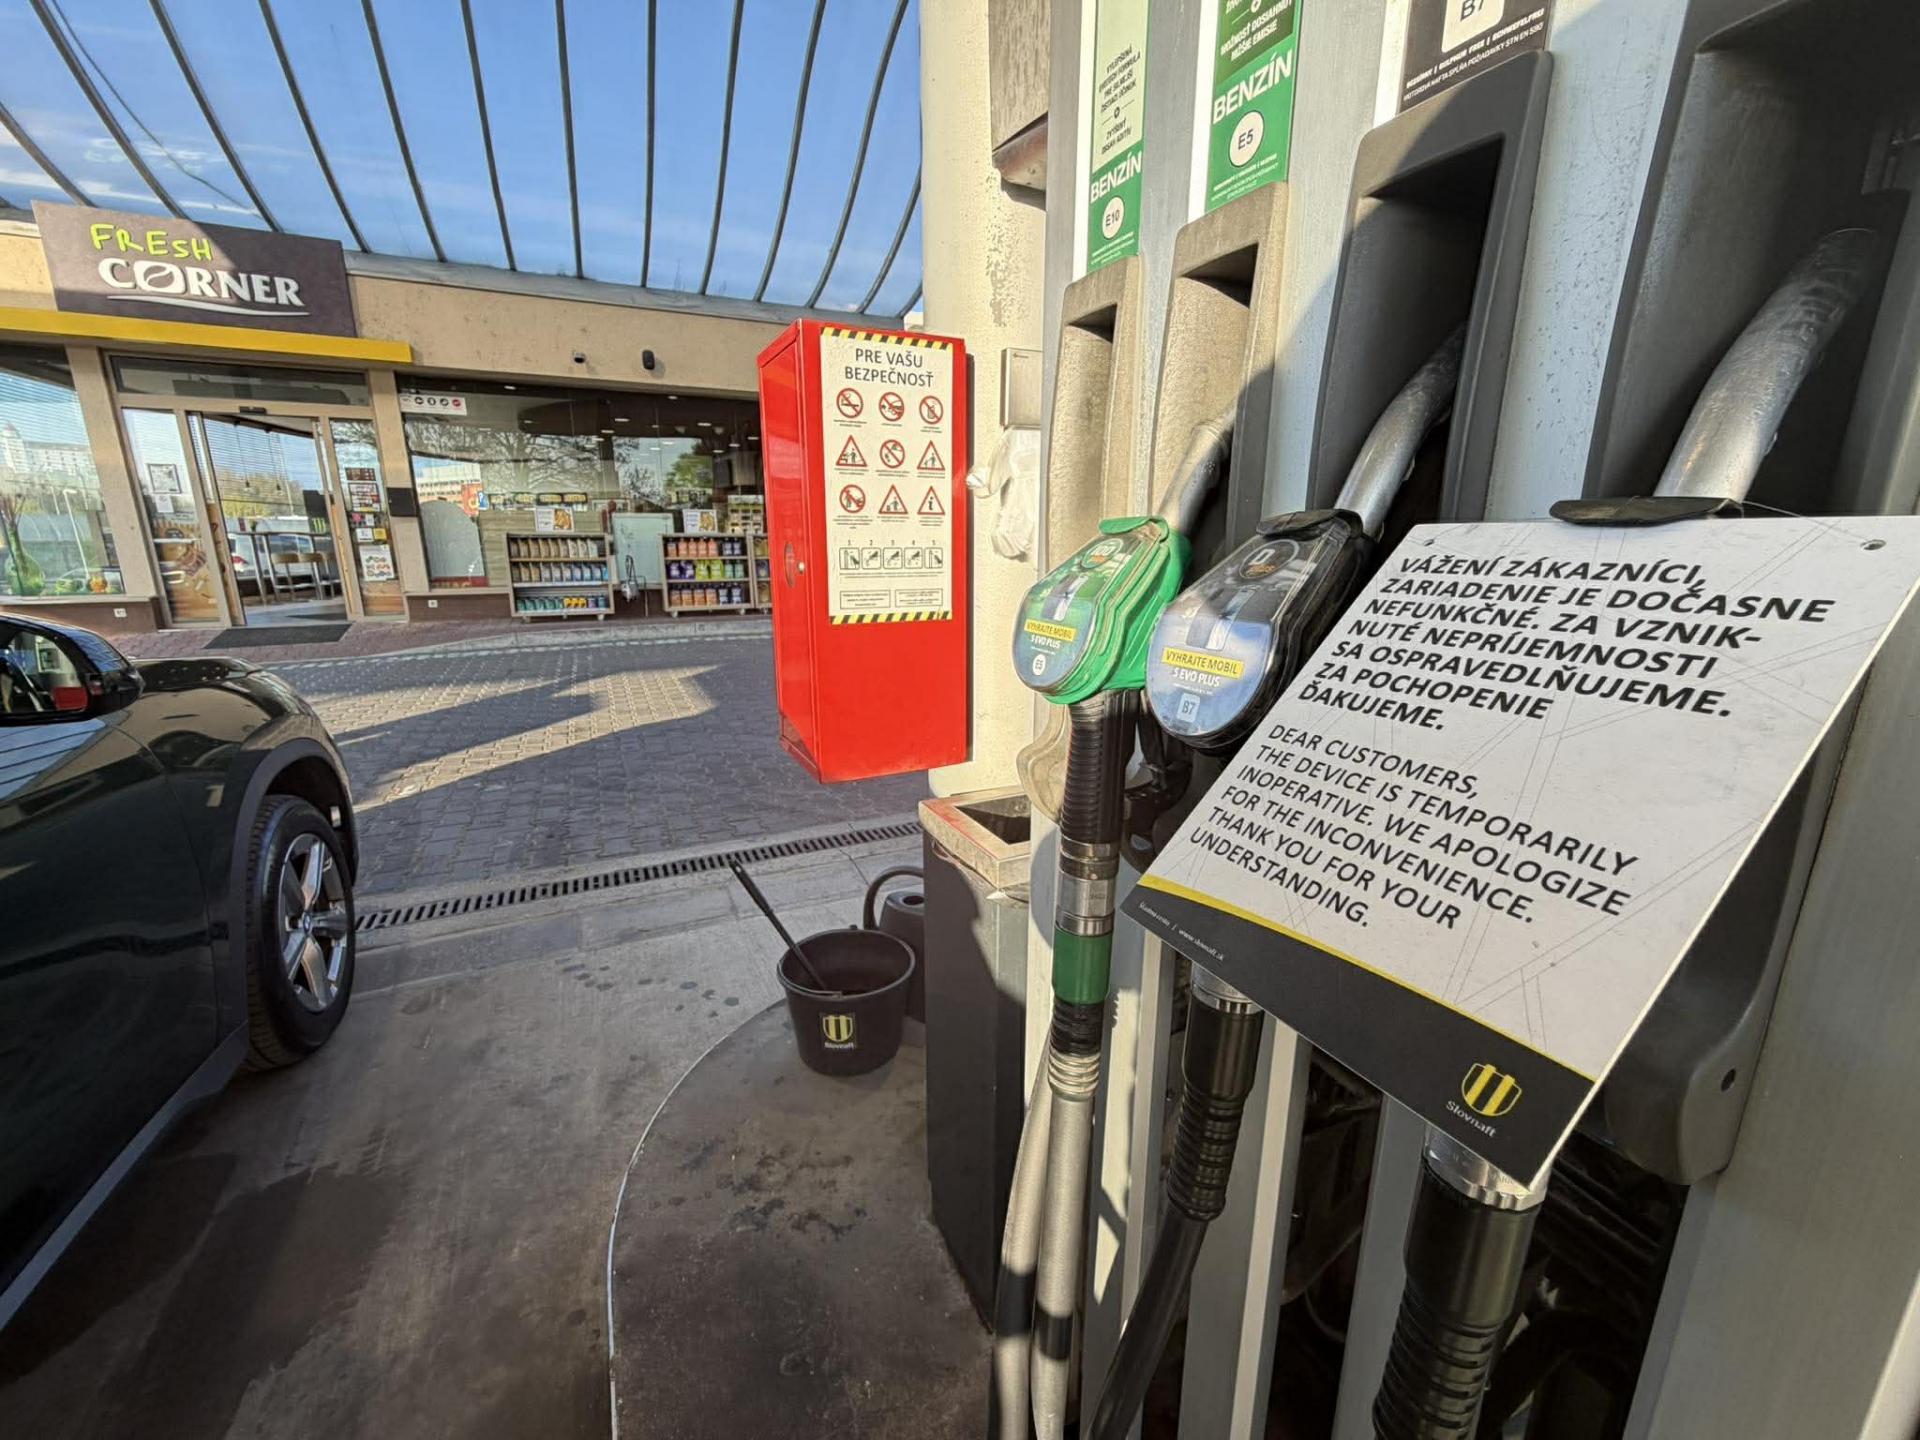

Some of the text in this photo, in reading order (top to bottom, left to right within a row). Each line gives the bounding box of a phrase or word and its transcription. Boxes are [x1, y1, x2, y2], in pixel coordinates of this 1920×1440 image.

[1212, 48, 1293, 125] BENZÍN
[1237, 129, 1254, 151] E5
[1090, 150, 1142, 204] BENZÍN
[89, 222, 214, 262] FRESH
[1105, 209, 1121, 227] E10
[97, 256, 306, 308] CORNER
[844, 366, 934, 388] BEZPEČNOSŤ
[855, 347, 924, 369] PRE VAŠU
[1400, 554, 1706, 593] VÁŽENÍ ZÁKAZNÍCI,
[1364, 598, 1763, 649] NEFUNKČNÉ. ZA VZNIK-
[1380, 577, 1836, 623] ZARIADENIE JE DOČASNE
[1166, 650, 1240, 675] VYHRAJTE MOBIL
[1347, 619, 1719, 679] NUTÉ NEPRÍJEMNOSTI
[1179, 668, 1198, 682] EVO
[1198, 673, 1221, 687] PLUS
[1315, 662, 1554, 720] ZA POCHOPENIE
[1331, 640, 1731, 717] SA OSPRAVEDLŇUJEME.
[1182, 700, 1196, 715] B7
[1298, 680, 1445, 730] ĎAKUJEME.
[1268, 724, 1479, 800] DEAR CUSTOMERS,
[1255, 744, 1640, 877] THE DEVICE IS TEMPORARILY
[1220, 785, 1535, 924] FOR THE INCONVENIENCE.
[1236, 764, 1632, 917] INOPERATIVE. WE APOLOGIZE
[1189, 826, 1370, 928] UNDERSTANDING.
[1207, 806, 1462, 930] THANK YOU FOR YOUR
[1445, 1100, 1497, 1138] Slovnaft
